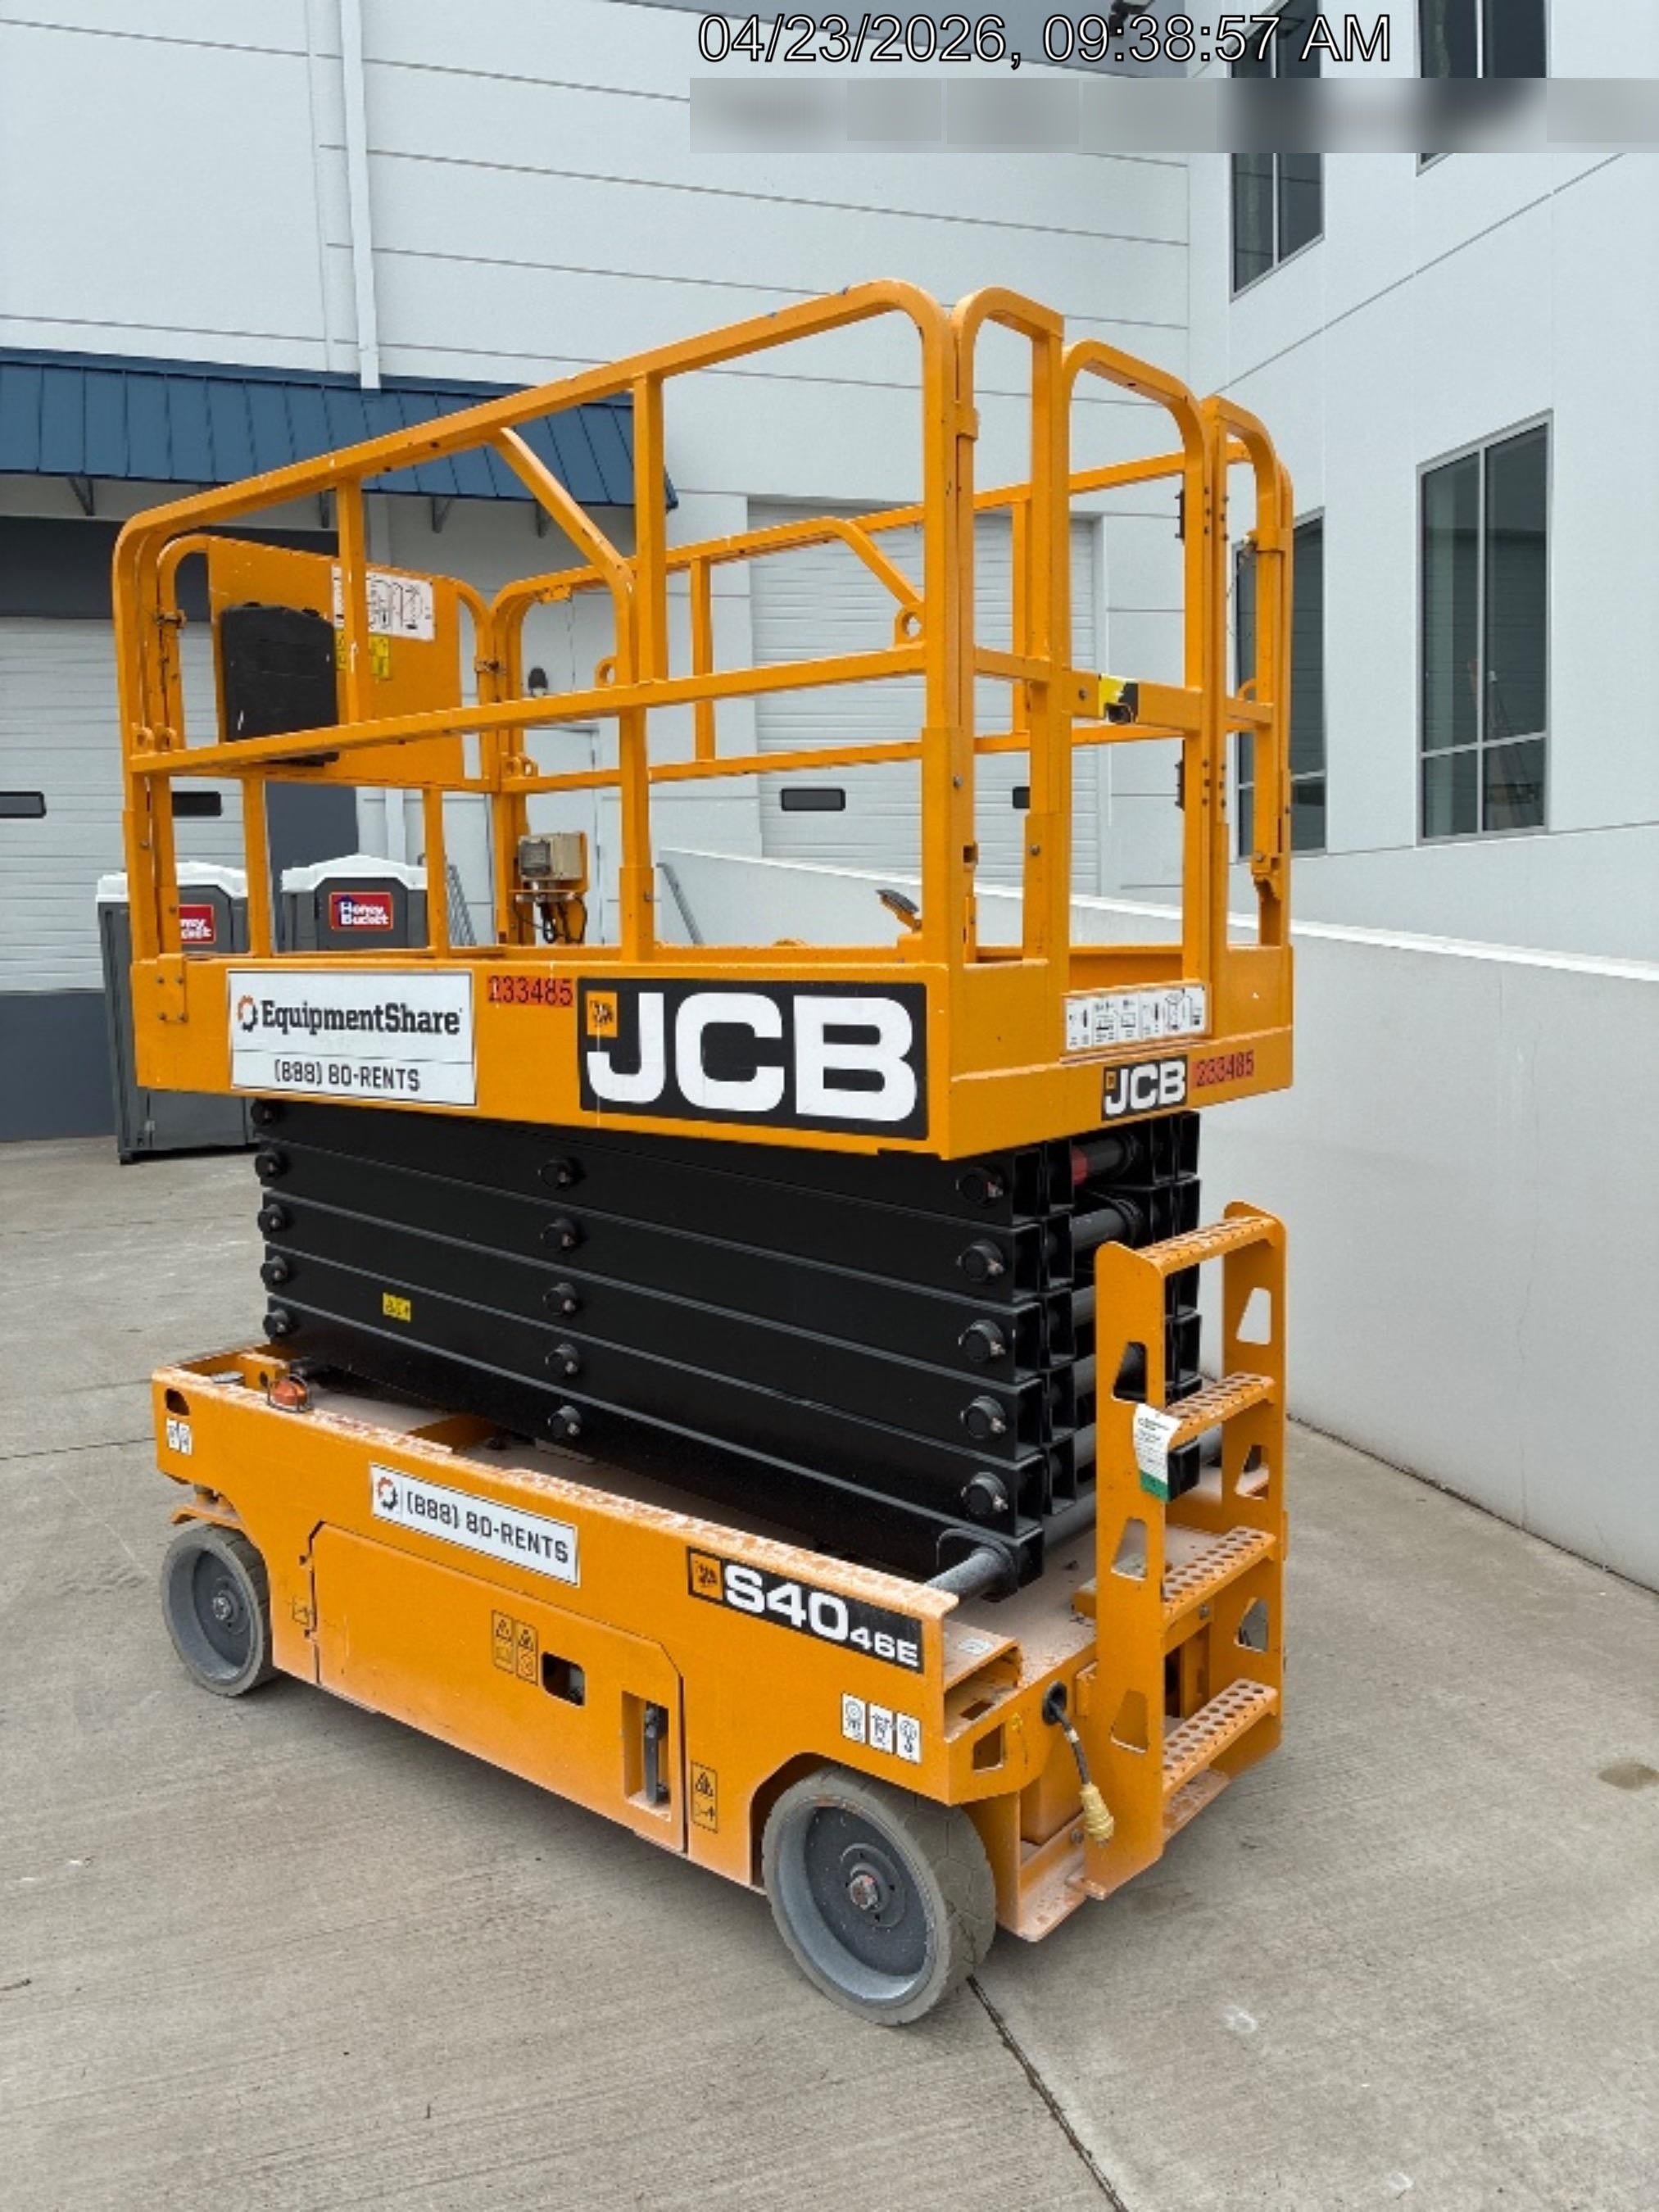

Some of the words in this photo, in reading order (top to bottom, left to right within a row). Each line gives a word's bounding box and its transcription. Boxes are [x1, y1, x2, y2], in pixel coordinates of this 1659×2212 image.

[261, 1000, 460, 1035] EquipmentShare
[274, 1059, 323, 1086] (888)
[587, 991, 918, 1122] JCB
[1104, 1060, 1185, 1115] JCB
[407, 1491, 460, 1530] (888)
[466, 1512, 569, 1564] 80-RENTS
